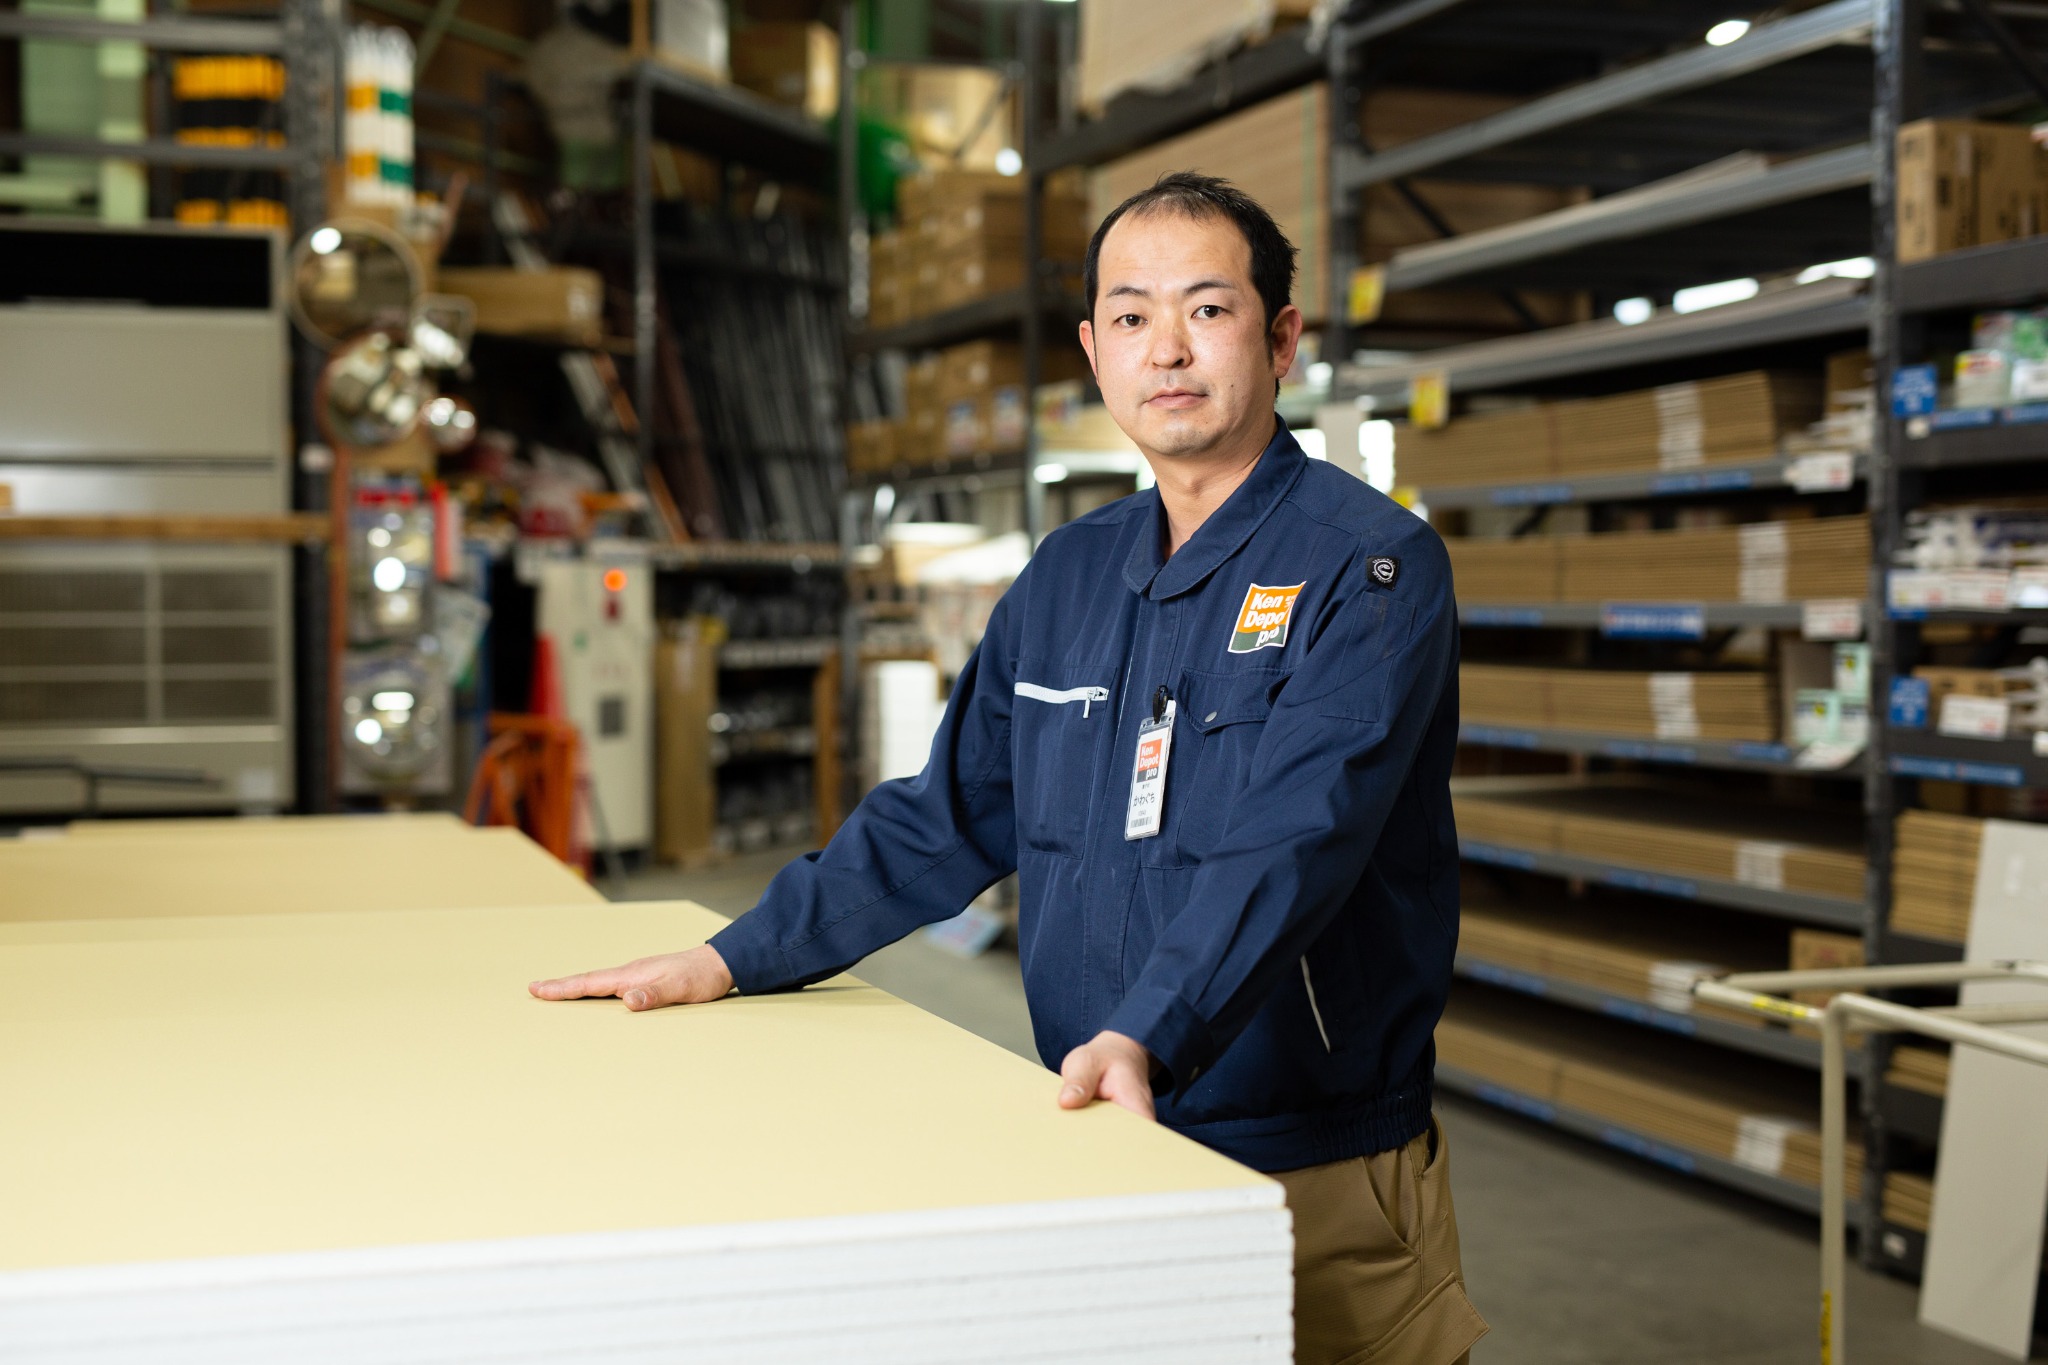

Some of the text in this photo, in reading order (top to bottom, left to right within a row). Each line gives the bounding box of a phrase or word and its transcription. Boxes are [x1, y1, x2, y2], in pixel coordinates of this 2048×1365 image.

[1250, 593, 1284, 610] Ken
[1243, 608, 1288, 629] Depo
[1142, 746, 1153, 756] Ken
[1140, 753, 1159, 768] Depot
[1146, 768, 1157, 780] pro
